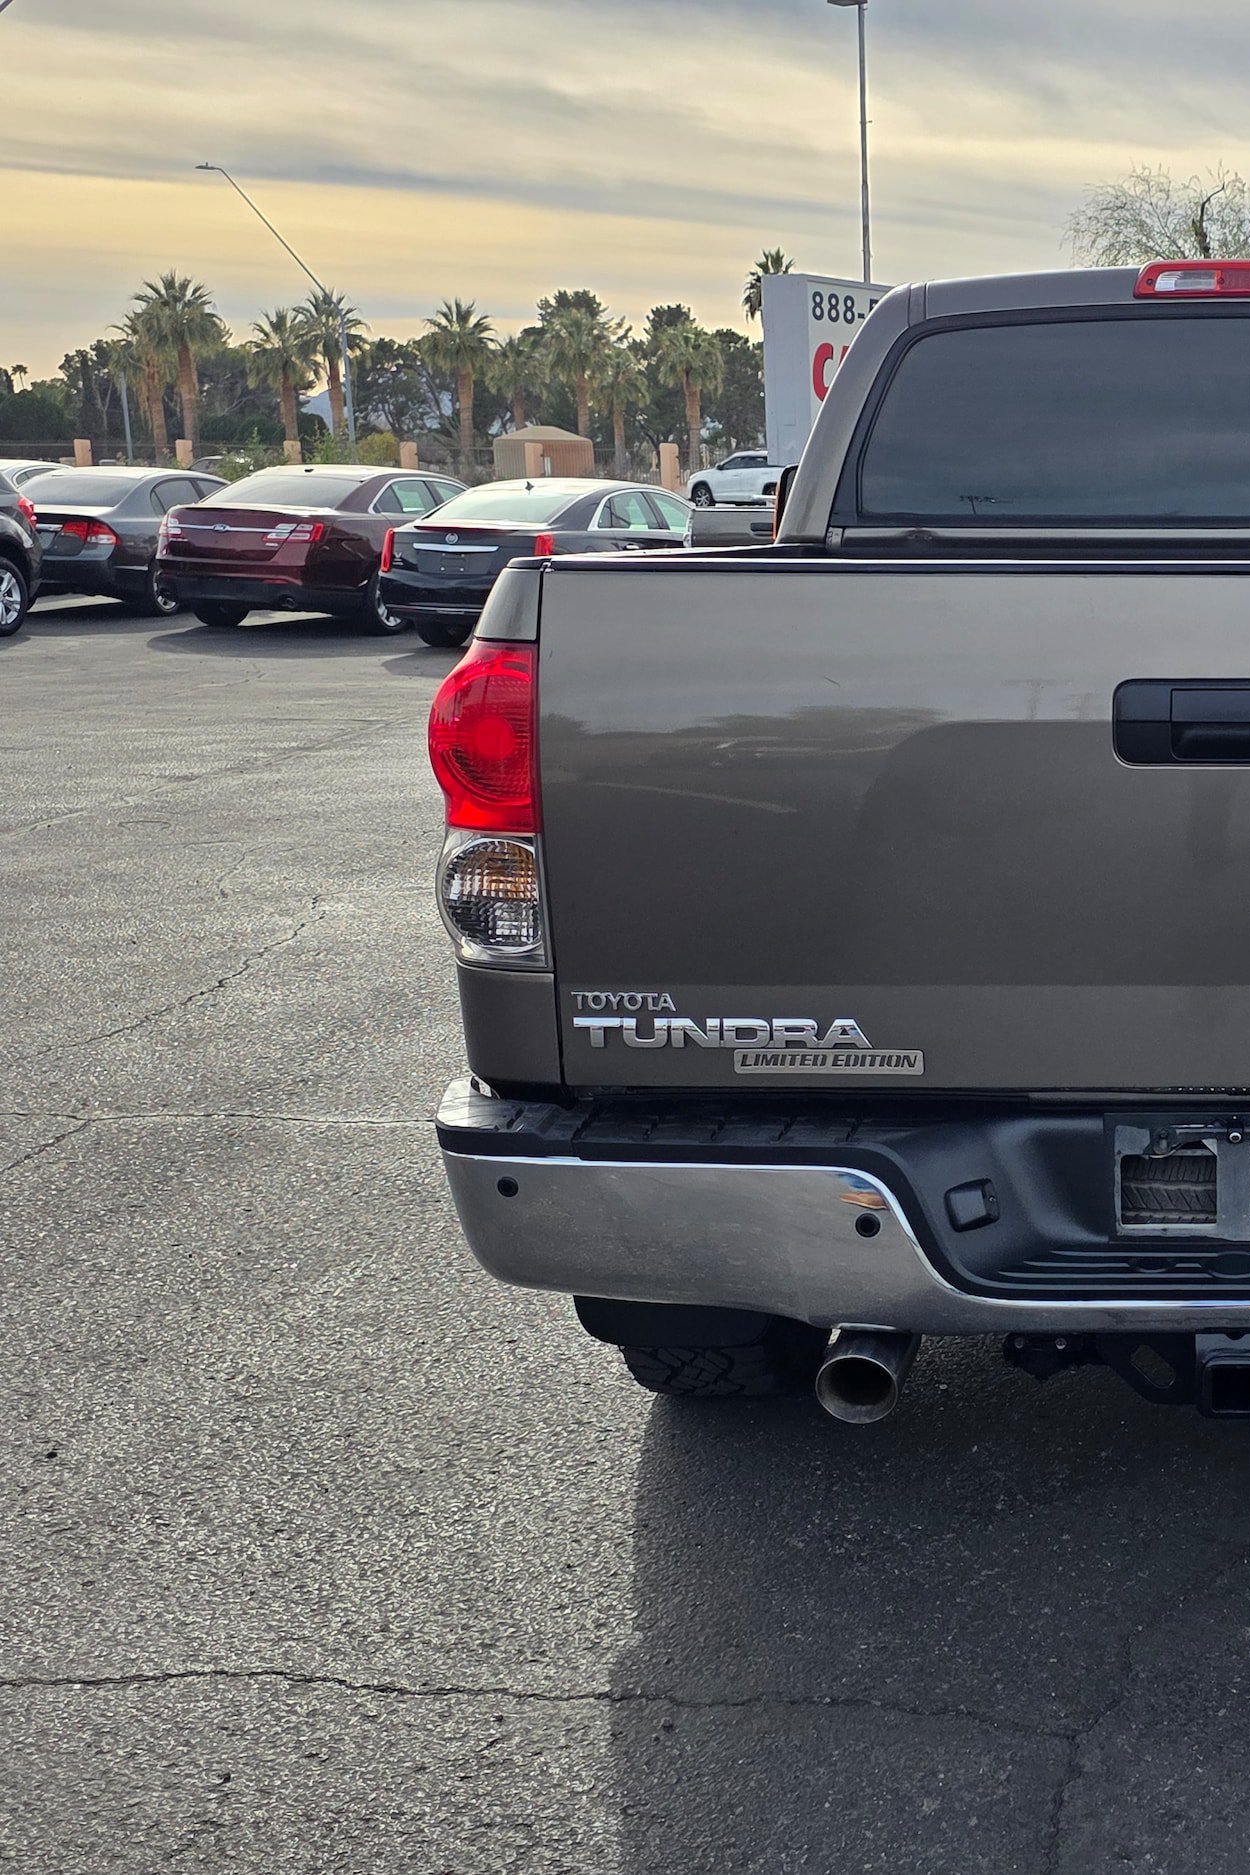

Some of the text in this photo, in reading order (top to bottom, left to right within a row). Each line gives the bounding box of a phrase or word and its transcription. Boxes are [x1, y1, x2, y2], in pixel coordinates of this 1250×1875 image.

[570, 990, 676, 1012] TOYOTA
[572, 1016, 873, 1049] TUNDRA
[740, 1053, 920, 1069] LIMITED EDITION
